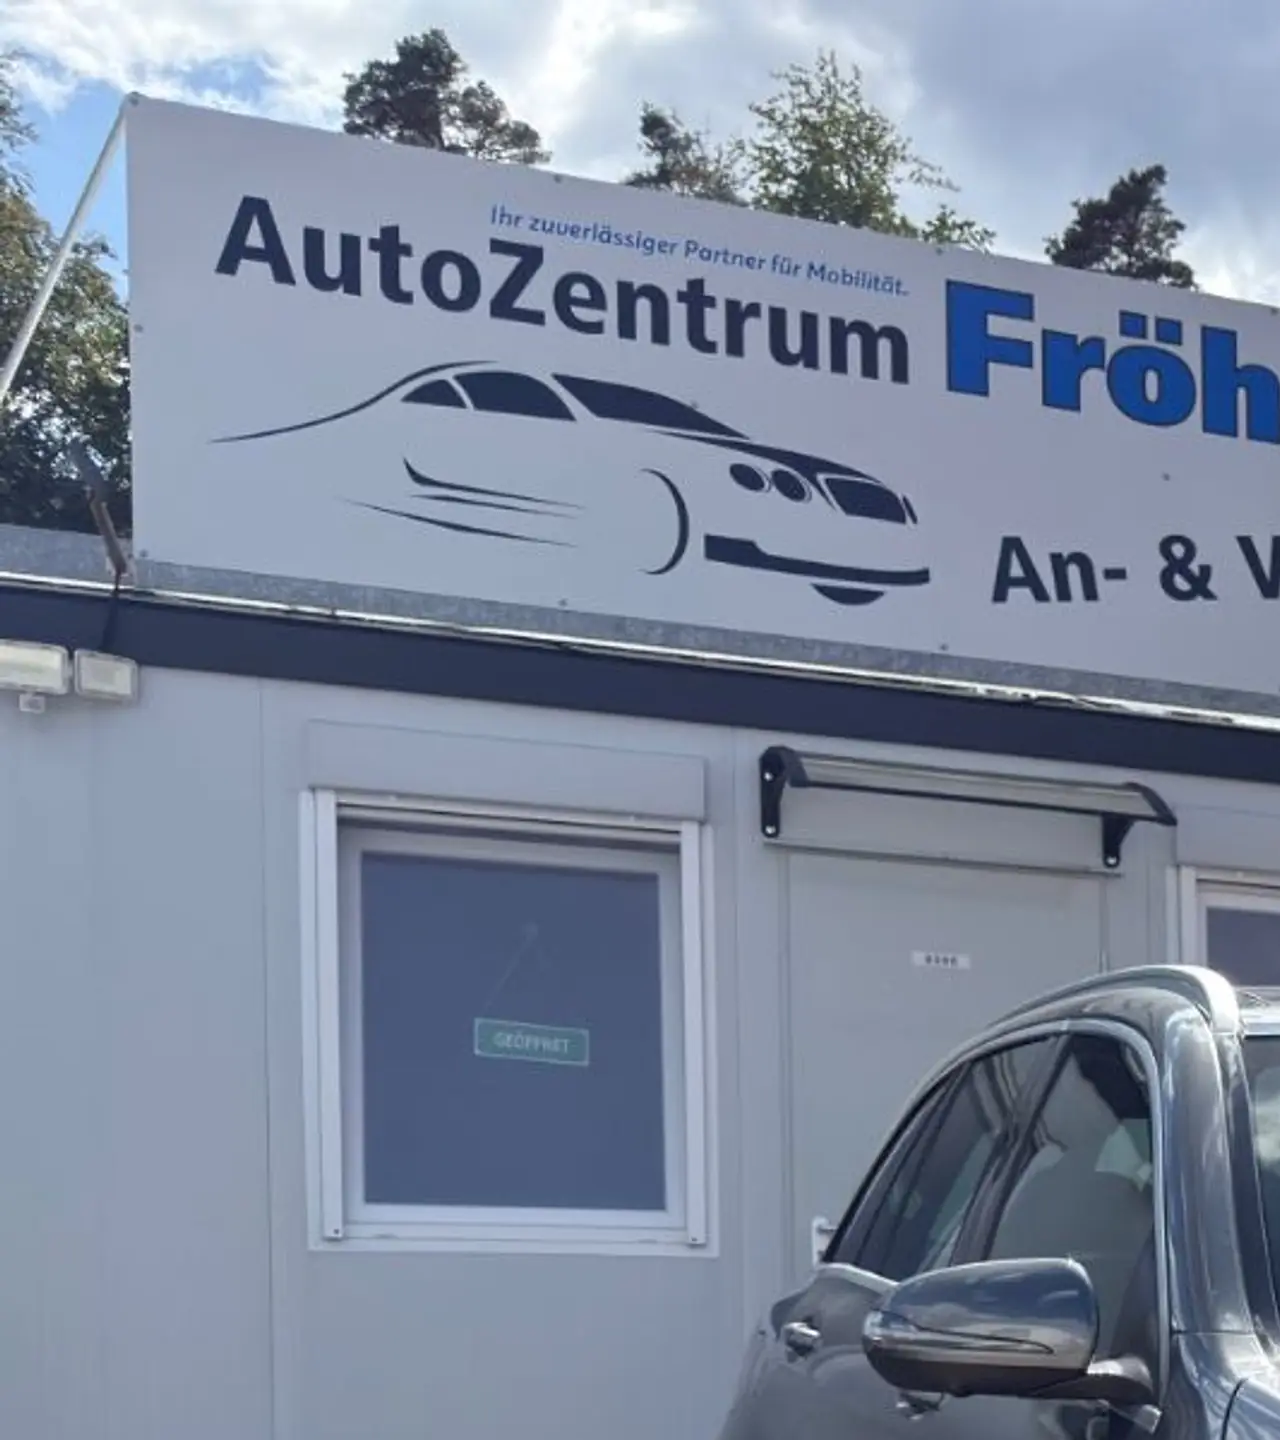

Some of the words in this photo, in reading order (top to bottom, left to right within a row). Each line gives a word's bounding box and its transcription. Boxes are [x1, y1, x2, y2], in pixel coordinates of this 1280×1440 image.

[491, 205, 524, 226] Ihr
[529, 216, 678, 256] zuverlässiger
[684, 240, 766, 271] Partner
[771, 254, 801, 279] für
[215, 196, 909, 385] AutoZentrum
[992, 535, 1127, 604] An-
[1159, 533, 1217, 601] &
